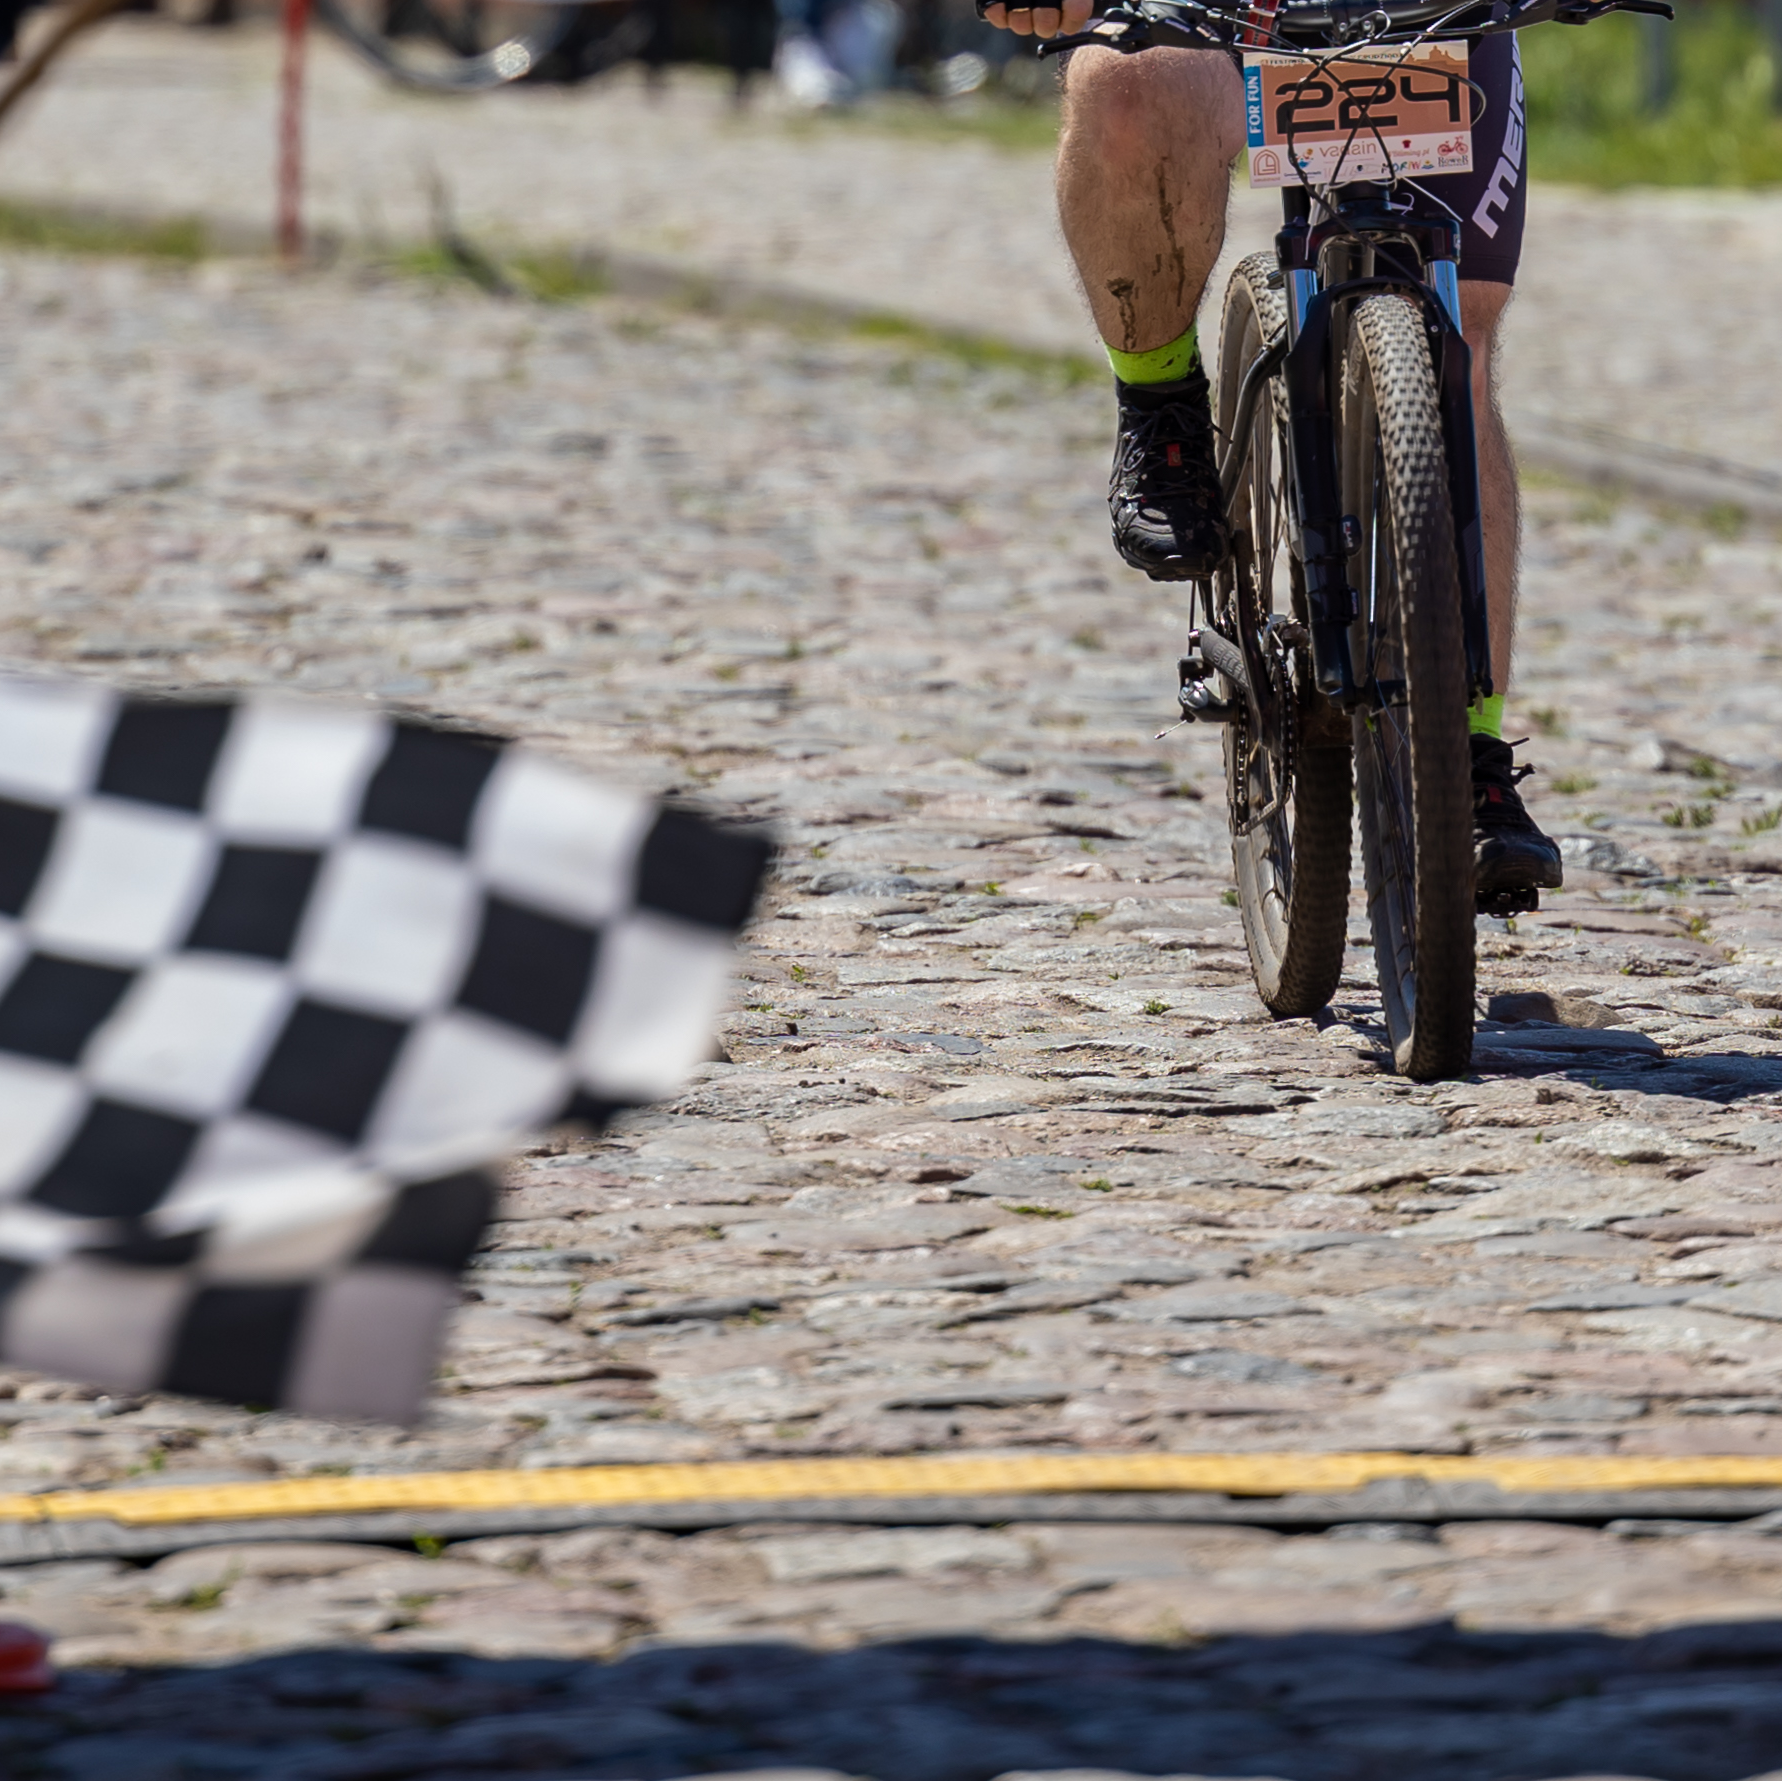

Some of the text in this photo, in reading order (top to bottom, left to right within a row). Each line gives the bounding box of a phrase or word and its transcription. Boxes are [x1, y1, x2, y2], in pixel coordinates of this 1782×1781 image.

[1247, 75, 1262, 135] FOR FUN
[1275, 73, 1461, 135] 224
